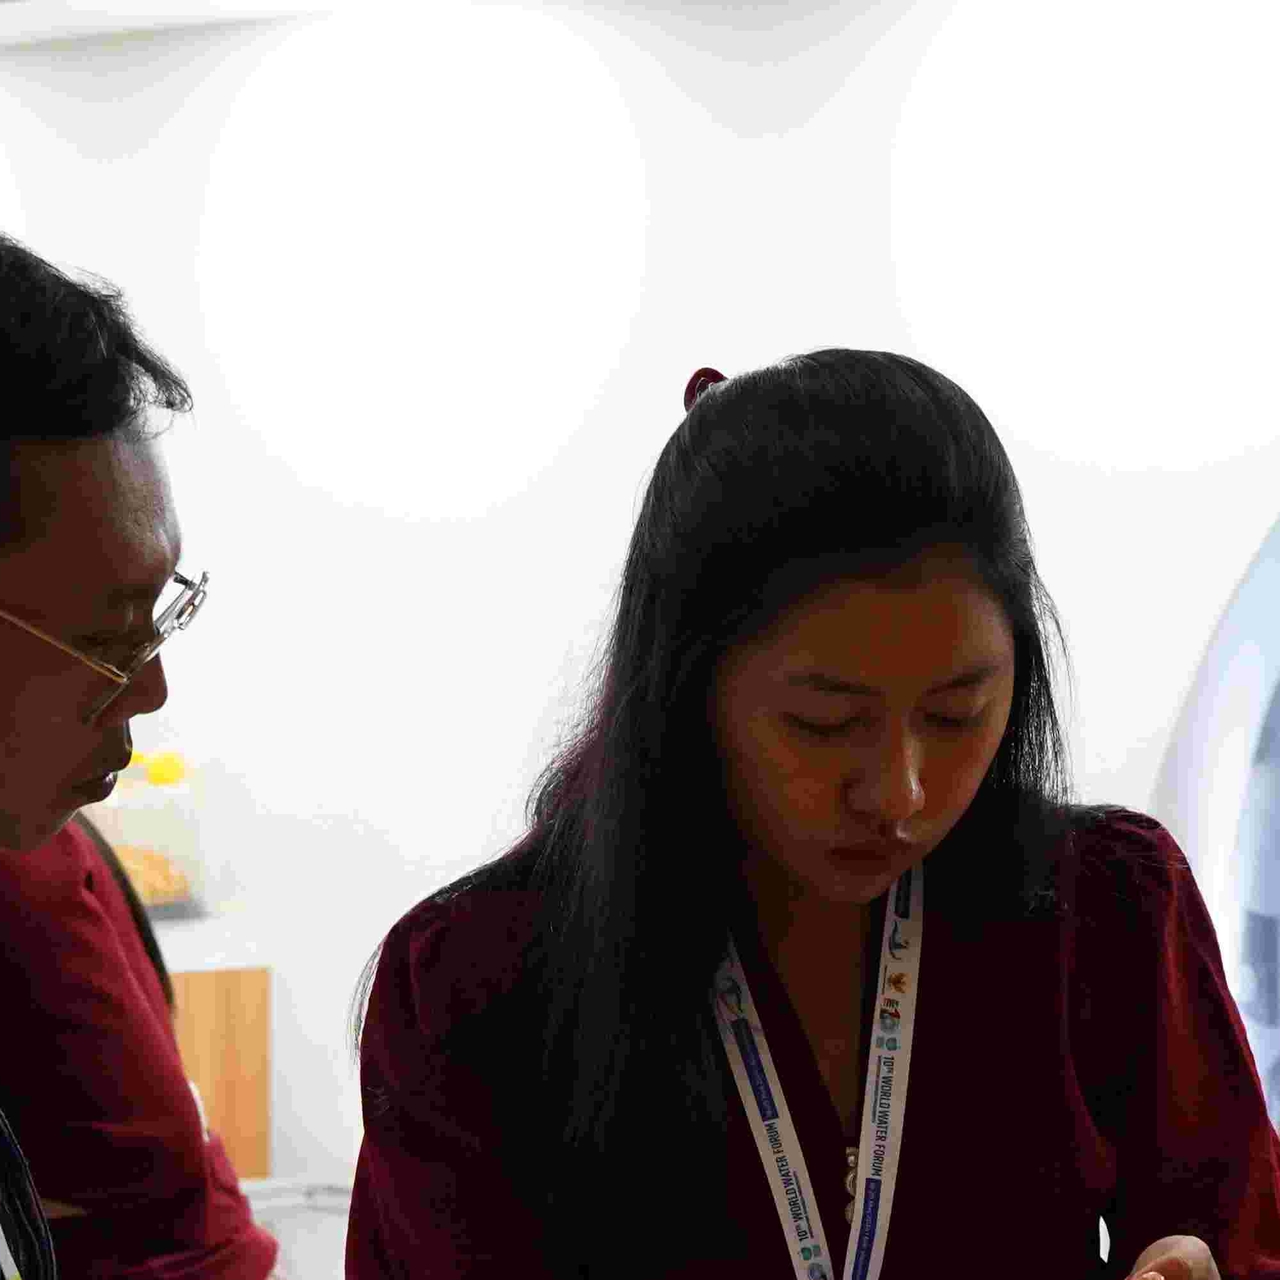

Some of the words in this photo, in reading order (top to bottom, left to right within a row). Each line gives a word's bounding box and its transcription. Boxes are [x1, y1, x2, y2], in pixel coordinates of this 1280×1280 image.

[876, 1076, 894, 1108] WORLD
[765, 1122, 786, 1155] FORUM
[874, 1109, 892, 1142] WATER
[776, 1155, 796, 1187] WATER
[870, 1143, 887, 1177] FORUM
[785, 1188, 805, 1223] WORLD
